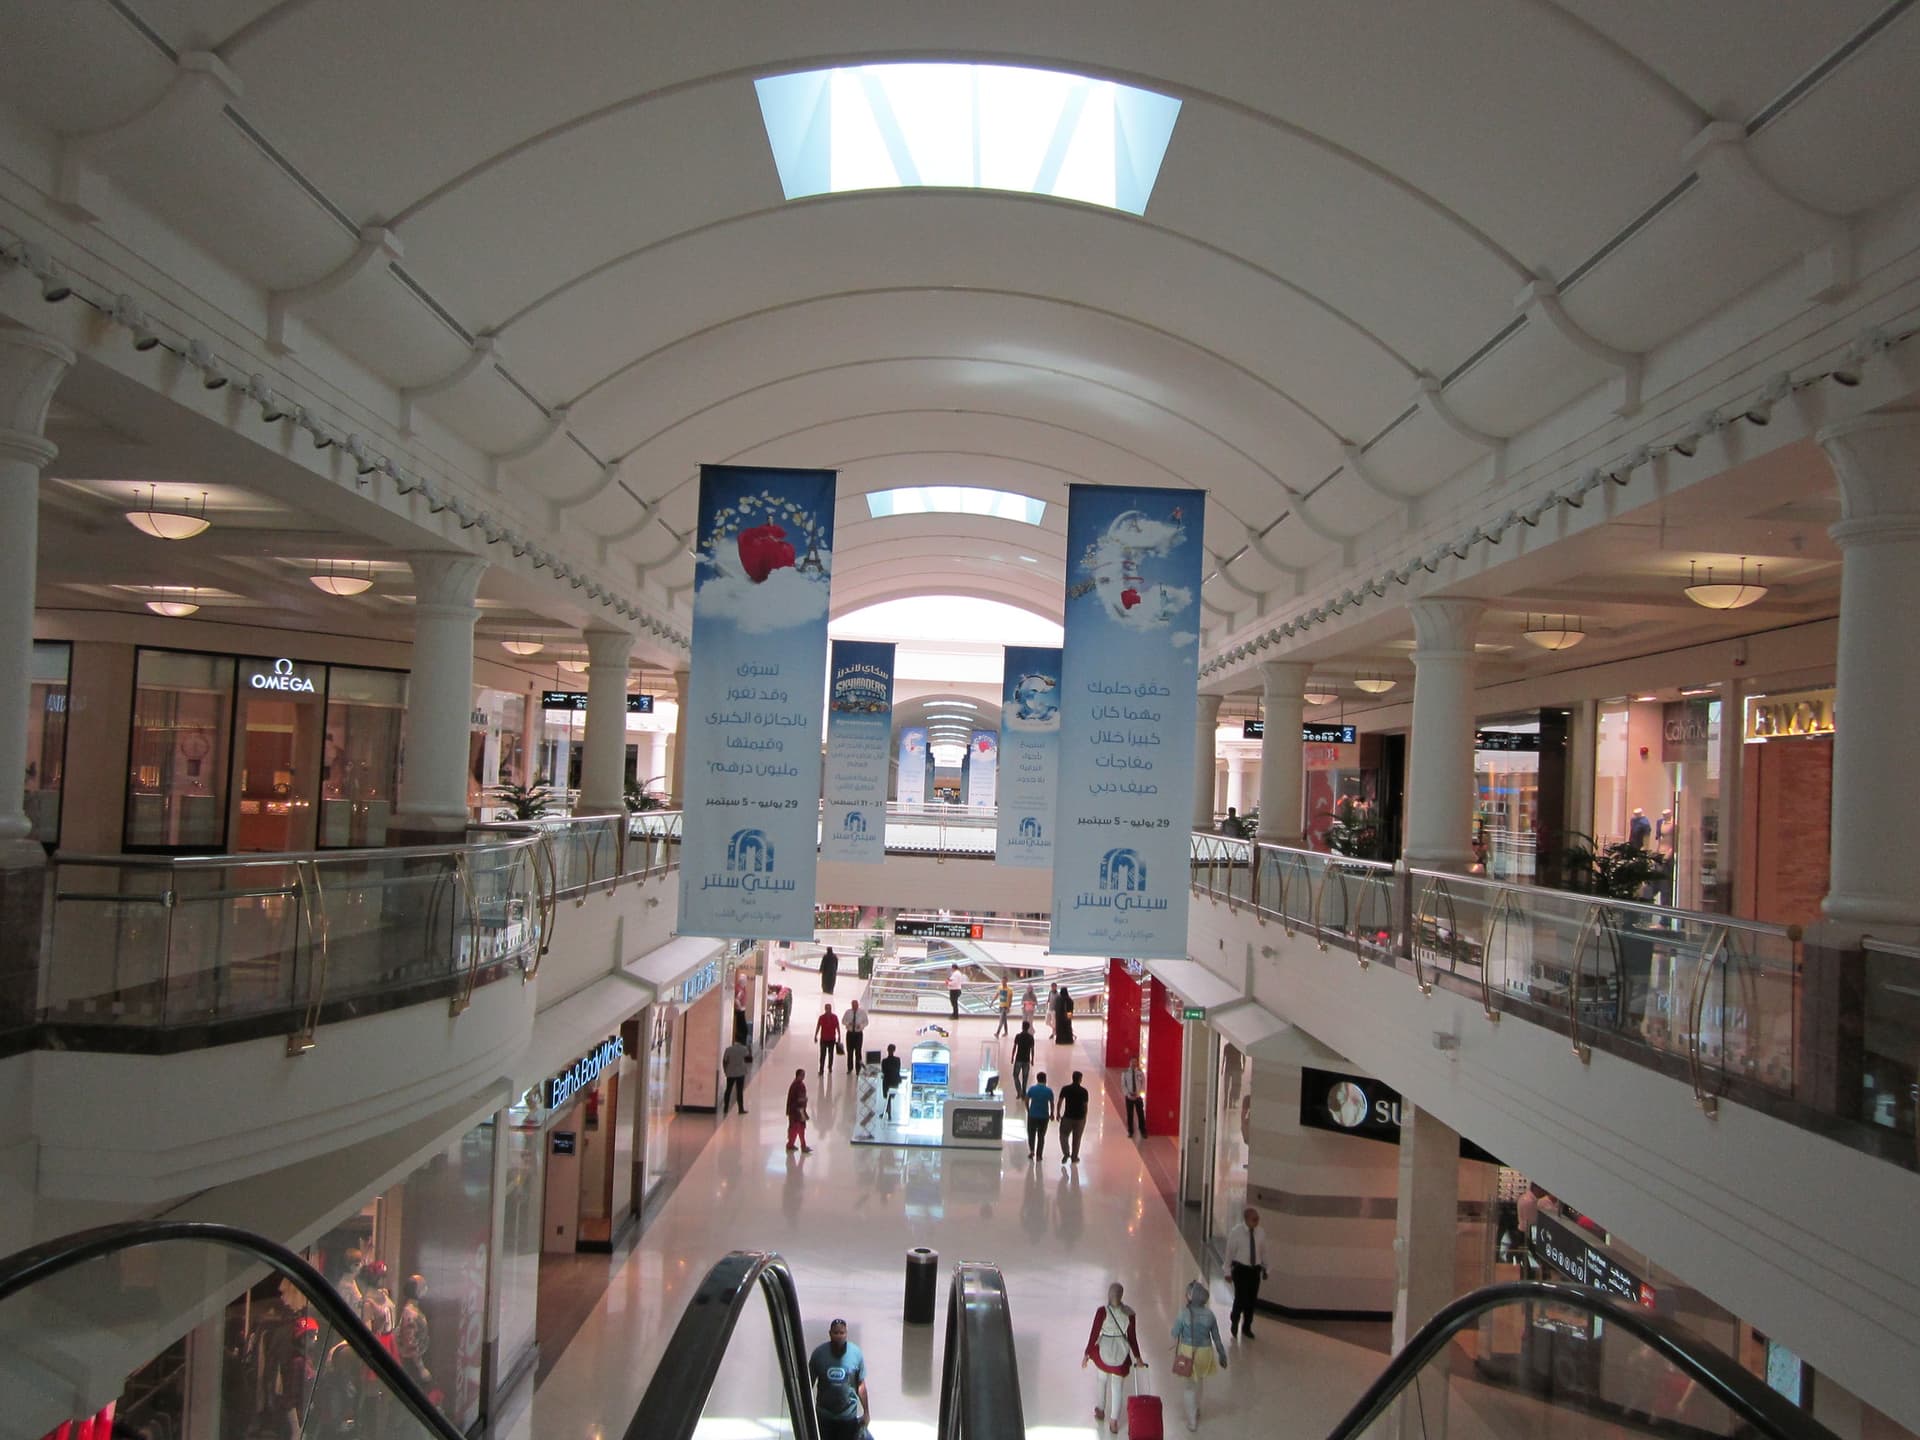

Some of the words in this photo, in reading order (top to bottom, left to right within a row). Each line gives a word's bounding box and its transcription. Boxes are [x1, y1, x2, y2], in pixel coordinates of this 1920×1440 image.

[251, 674, 315, 693] OMEGA
[1087, 680, 1131, 695] حلمك
[642, 701, 649, 709] 2
[1091, 704, 1120, 721] كان
[705, 711, 751, 725] الكبرى
[753, 711, 807, 727] بالجائزة
[1123, 706, 1160, 722] مهما
[1090, 730, 1124, 745] خلال
[1345, 731, 1352, 739] 2
[726, 736, 784, 752] وقيمتها
[756, 761, 799, 777] مليون
[1120, 779, 1158, 796] صيف
[705, 797, 740, 807] سبتمبر
[742, 798, 749, 806] 5
[758, 800, 783, 809] يوليو
[785, 800, 799, 808] 29
[1077, 816, 1112, 825] سبتمبر
[1114, 817, 1121, 825] 5
[1130, 819, 1154, 828] يوليو
[1156, 819, 1170, 828] 29
[700, 873, 739, 890] سنتر
[742, 873, 795, 895] سيتي
[1072, 893, 1111, 910] سنتر
[1114, 892, 1167, 913] سيتي
[552, 1069, 574, 1109] Bath
[573, 1063, 581, 1092] &
[580, 1048, 602, 1086] Body
[600, 1035, 624, 1070] Works
